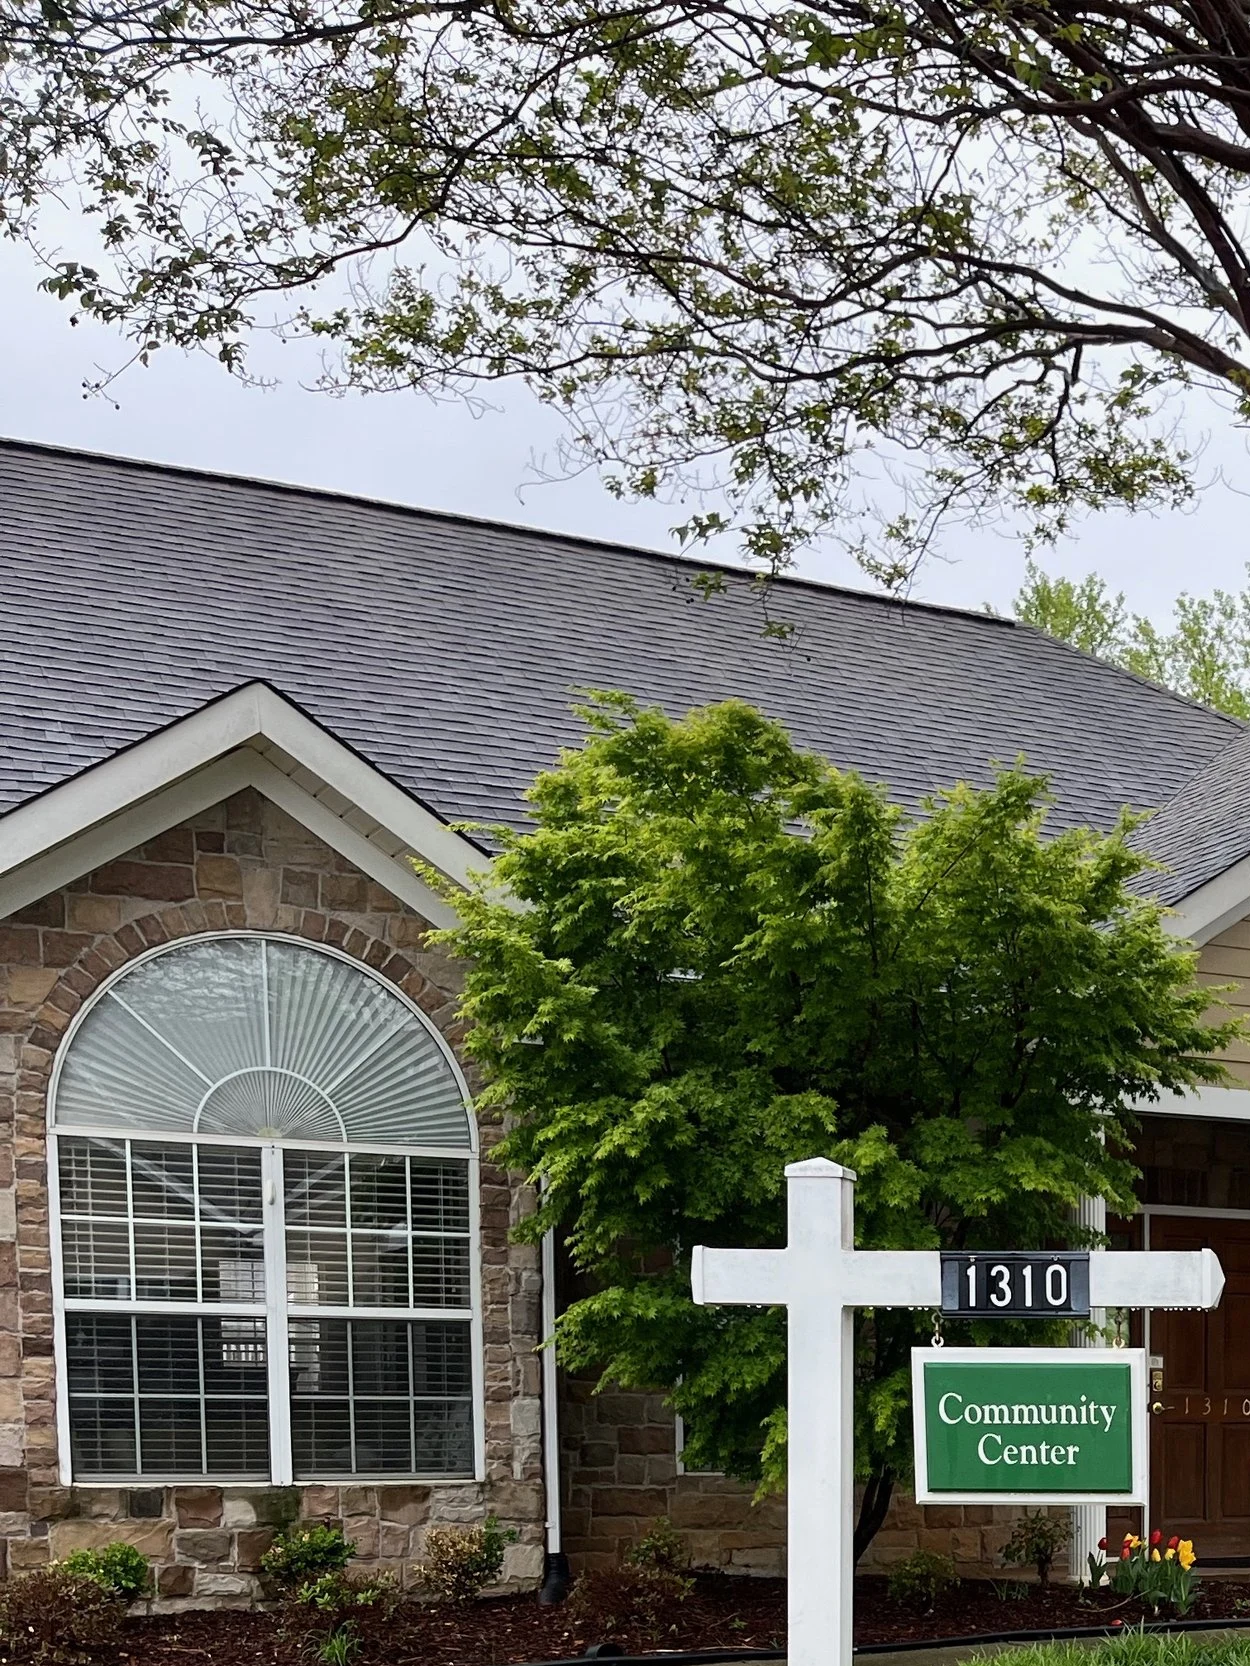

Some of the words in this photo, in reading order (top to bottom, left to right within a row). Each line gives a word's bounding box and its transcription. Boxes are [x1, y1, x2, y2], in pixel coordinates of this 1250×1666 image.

[966, 1264, 1068, 1308] 1310
[938, 1392, 1117, 1432] Community
[977, 1433, 1080, 1466] Center
